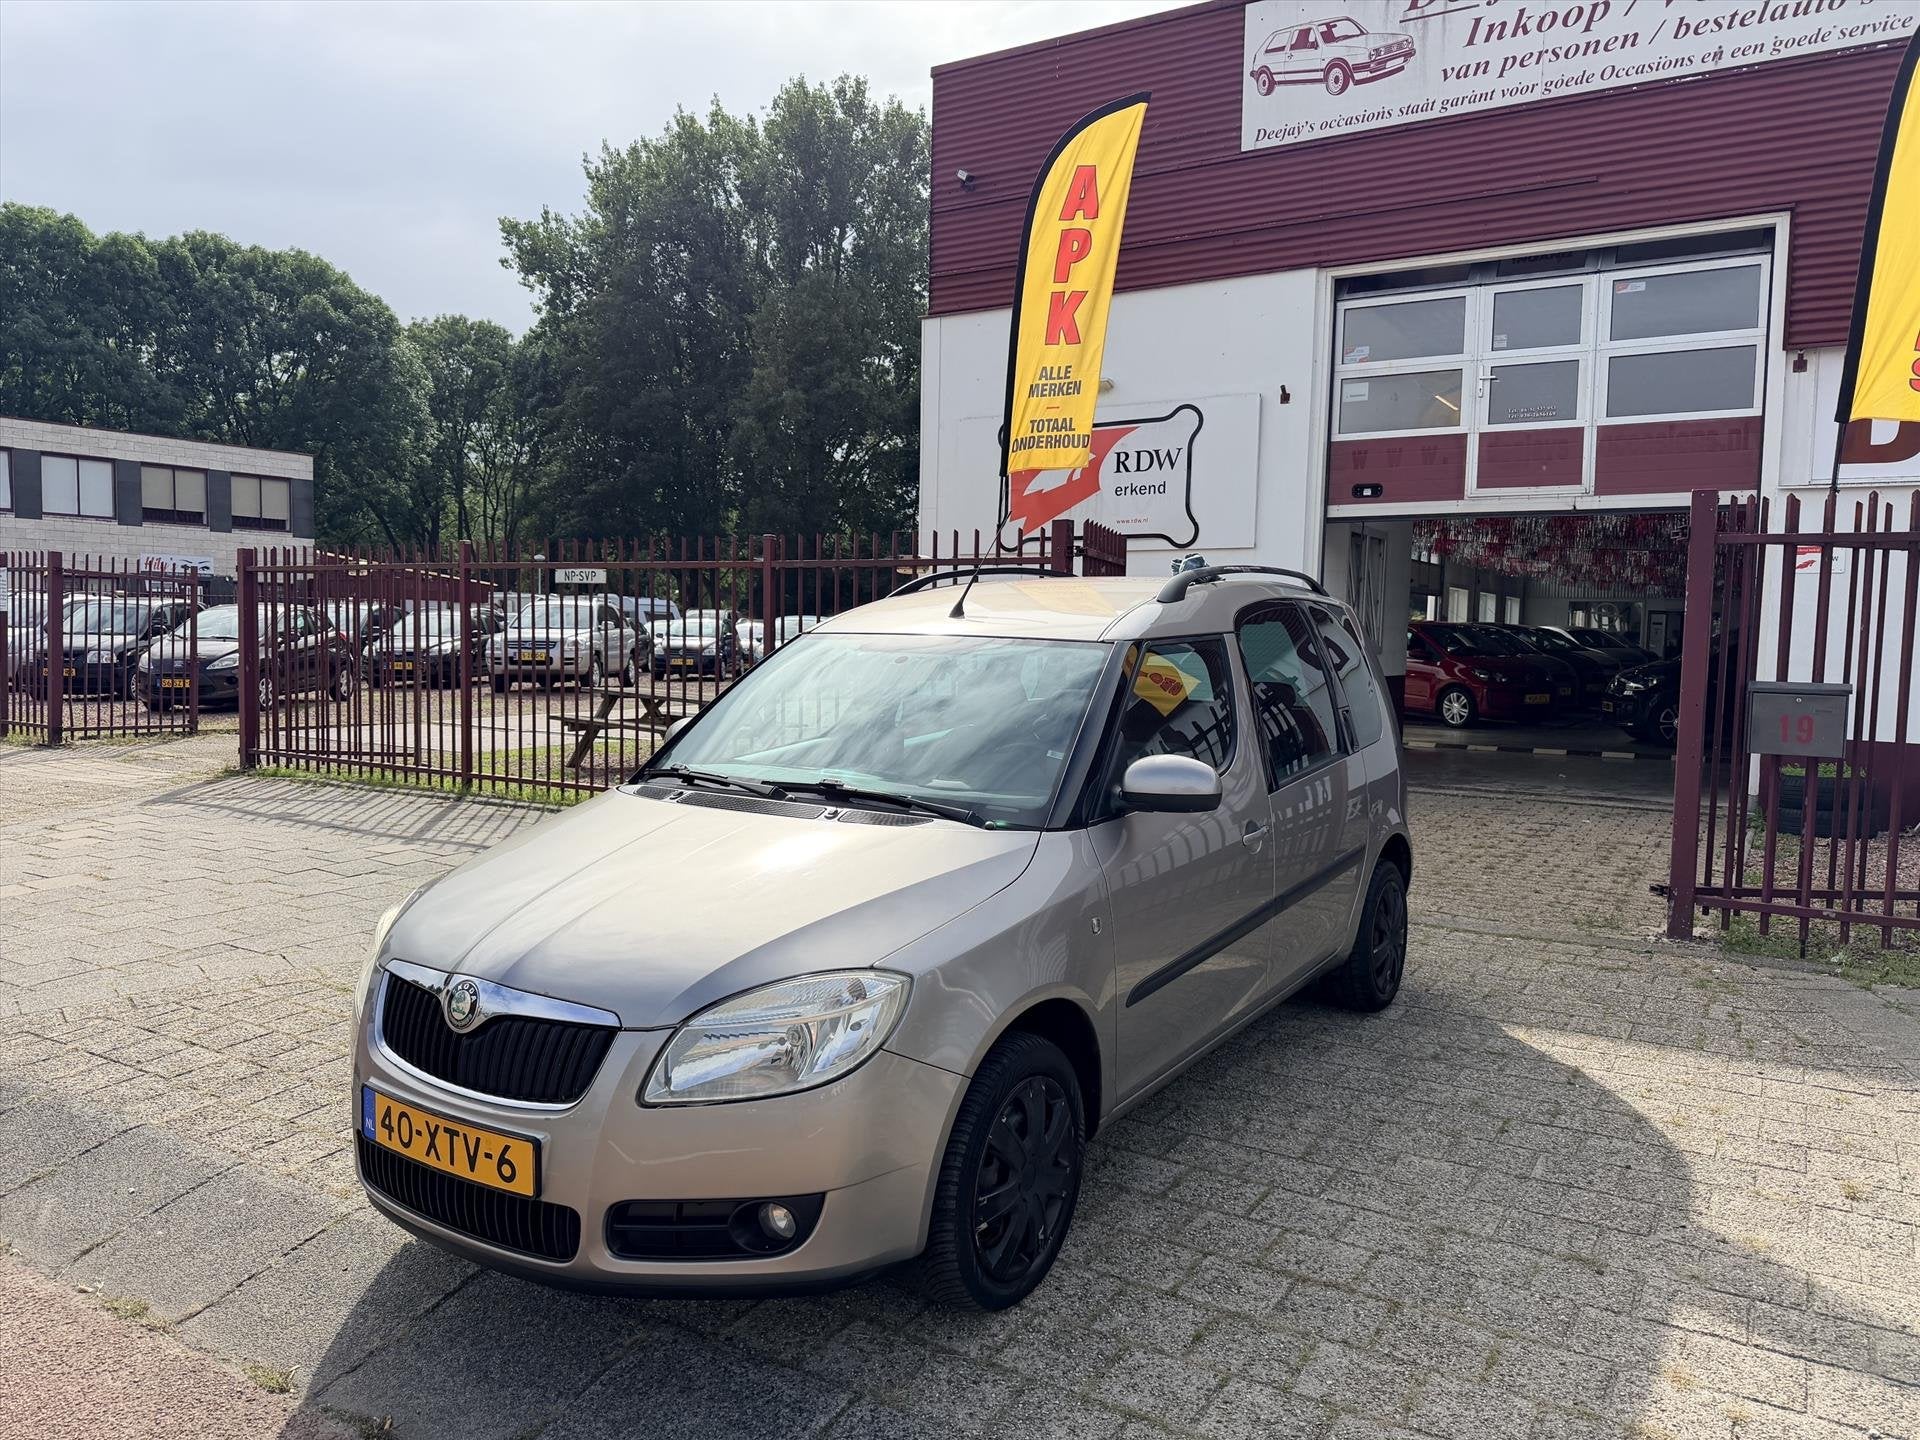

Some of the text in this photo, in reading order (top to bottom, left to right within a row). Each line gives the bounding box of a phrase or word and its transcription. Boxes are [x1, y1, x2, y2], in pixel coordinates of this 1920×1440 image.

[1462, 0, 1611, 48] Inkoop
[1441, 0, 1874, 82] van personen / bestelauto
[1255, 14, 1914, 143] Deejay's occasions staat garant voor goede Occasions en een goede service
[1044, 164, 1099, 346] APK
[1039, 365, 1072, 381] ALLE
[1028, 380, 1082, 398] MERKEN
[1030, 417, 1076, 433] TOTAAL
[1012, 434, 1090, 453] ONDERHOUD
[1114, 447, 1183, 474] RDW
[1115, 481, 1166, 497] erkend
[1116, 517, 1149, 525] www.rdw.nl
[564, 570, 597, 581] NP-SVP
[1779, 713, 1814, 744] 19
[365, 1105, 517, 1184] NL 40-XTV-6
